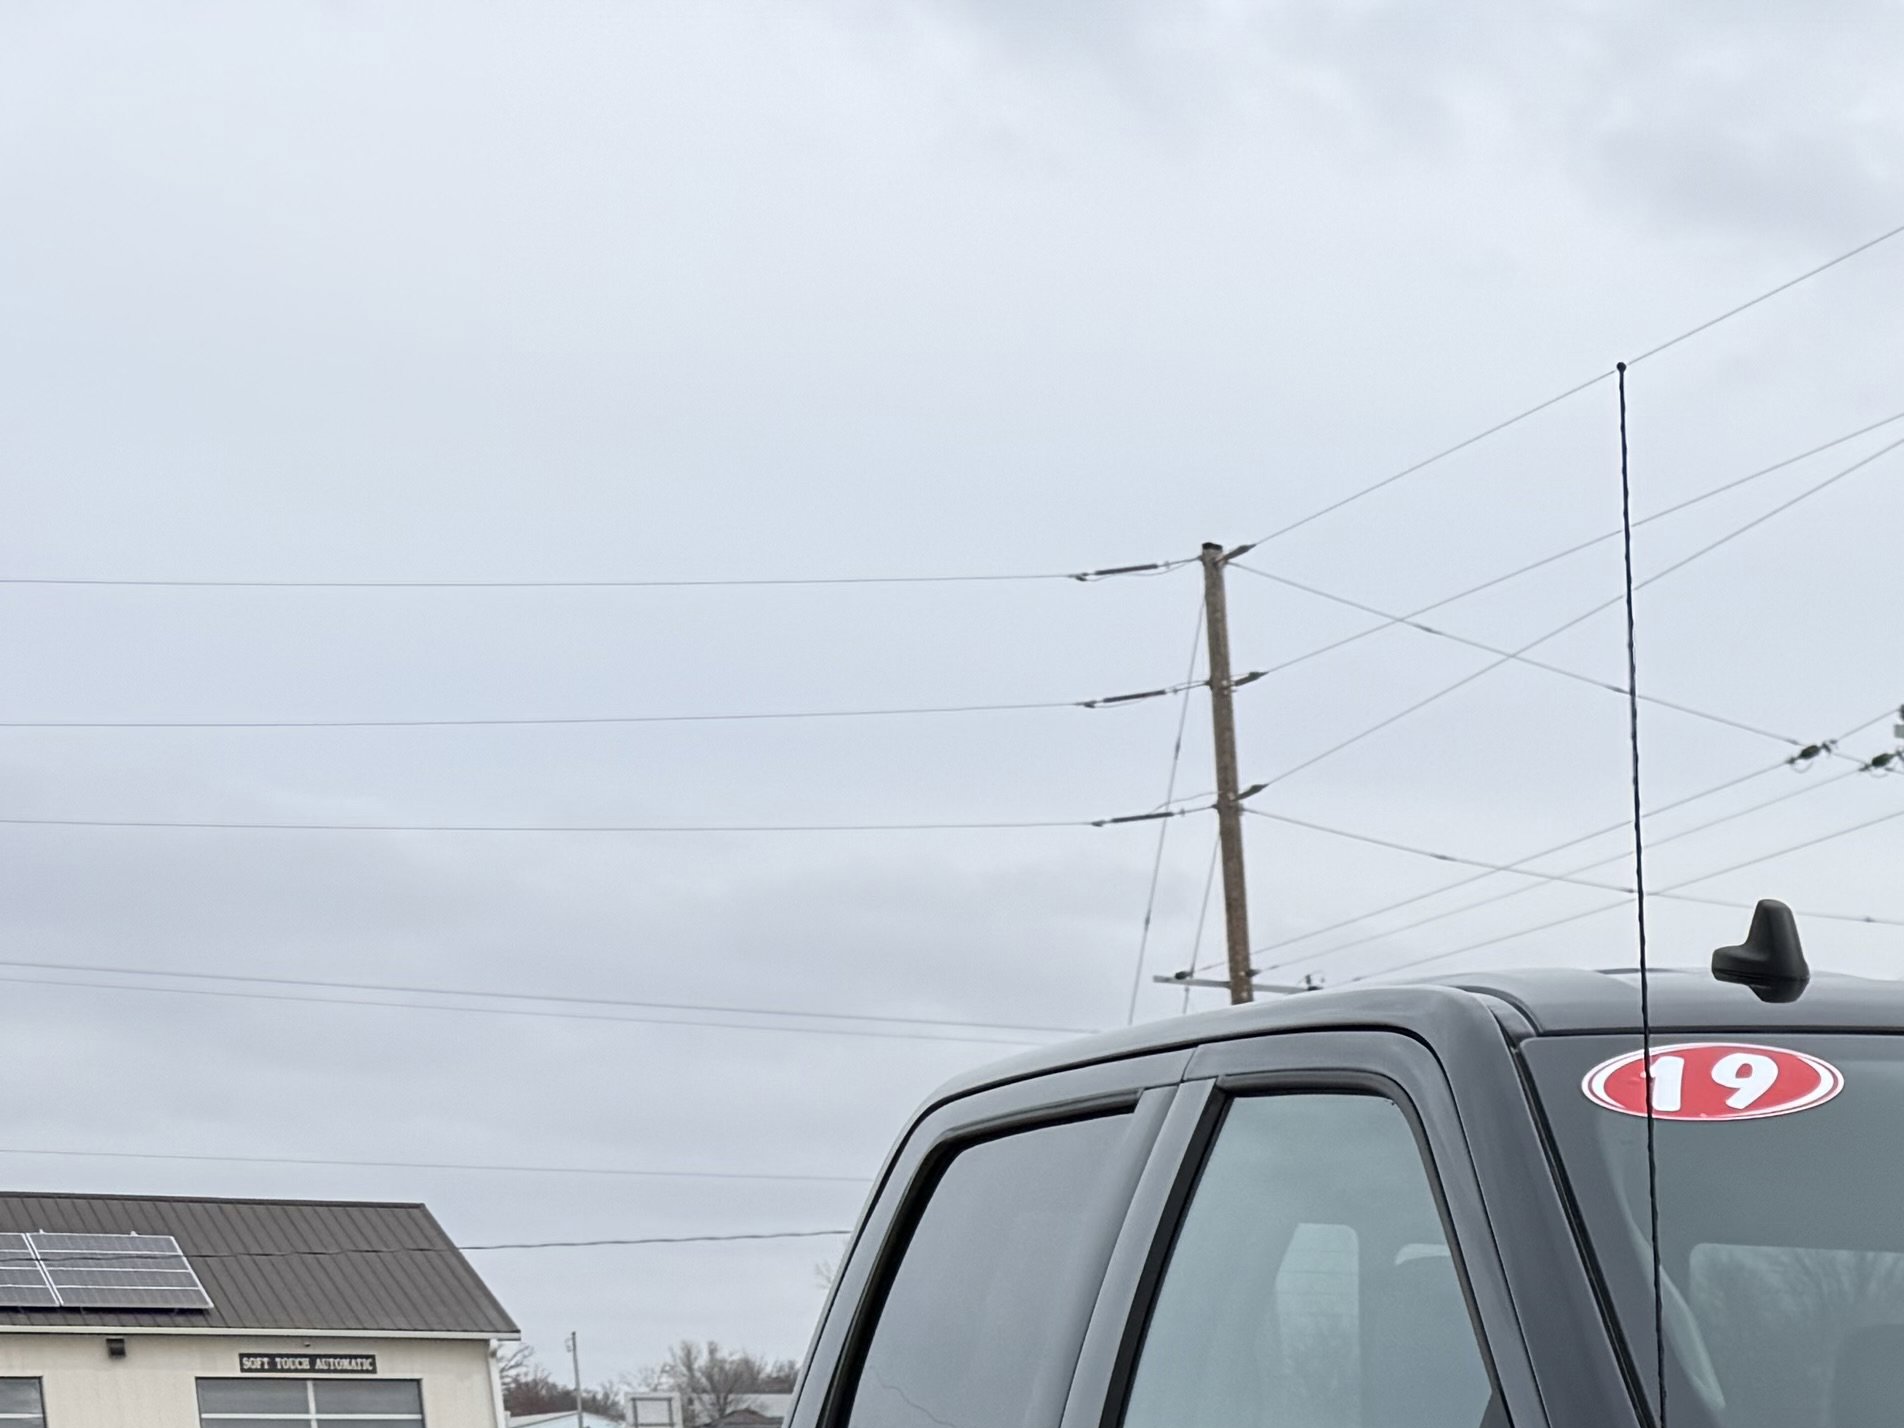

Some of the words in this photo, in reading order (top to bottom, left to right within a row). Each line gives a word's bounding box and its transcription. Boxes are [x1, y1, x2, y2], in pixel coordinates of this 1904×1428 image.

[1642, 1053, 1779, 1111] 19
[242, 1357, 269, 1370] SOFT
[275, 1357, 310, 1370] TOUCH
[315, 1358, 374, 1370] AUTOMATIC
